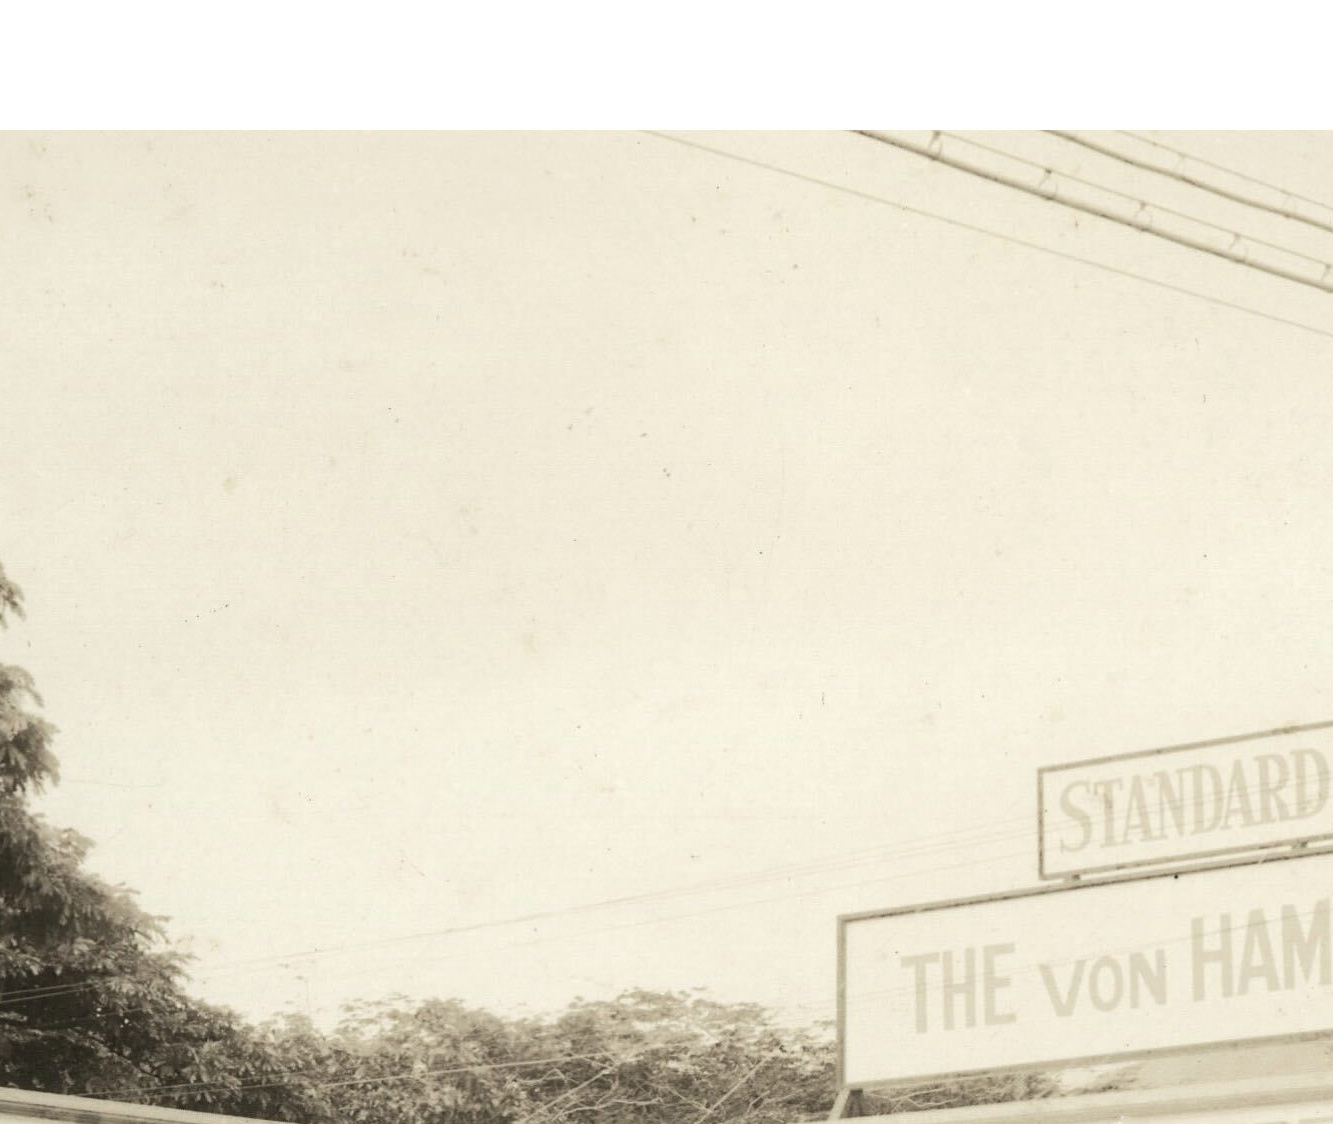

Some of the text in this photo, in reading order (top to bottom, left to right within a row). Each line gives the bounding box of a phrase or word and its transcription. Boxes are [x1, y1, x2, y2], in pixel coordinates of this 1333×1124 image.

[1057, 746, 1330, 856] STANDARD
[900, 942, 1017, 1035] THE
[1038, 949, 1167, 1018] VON
